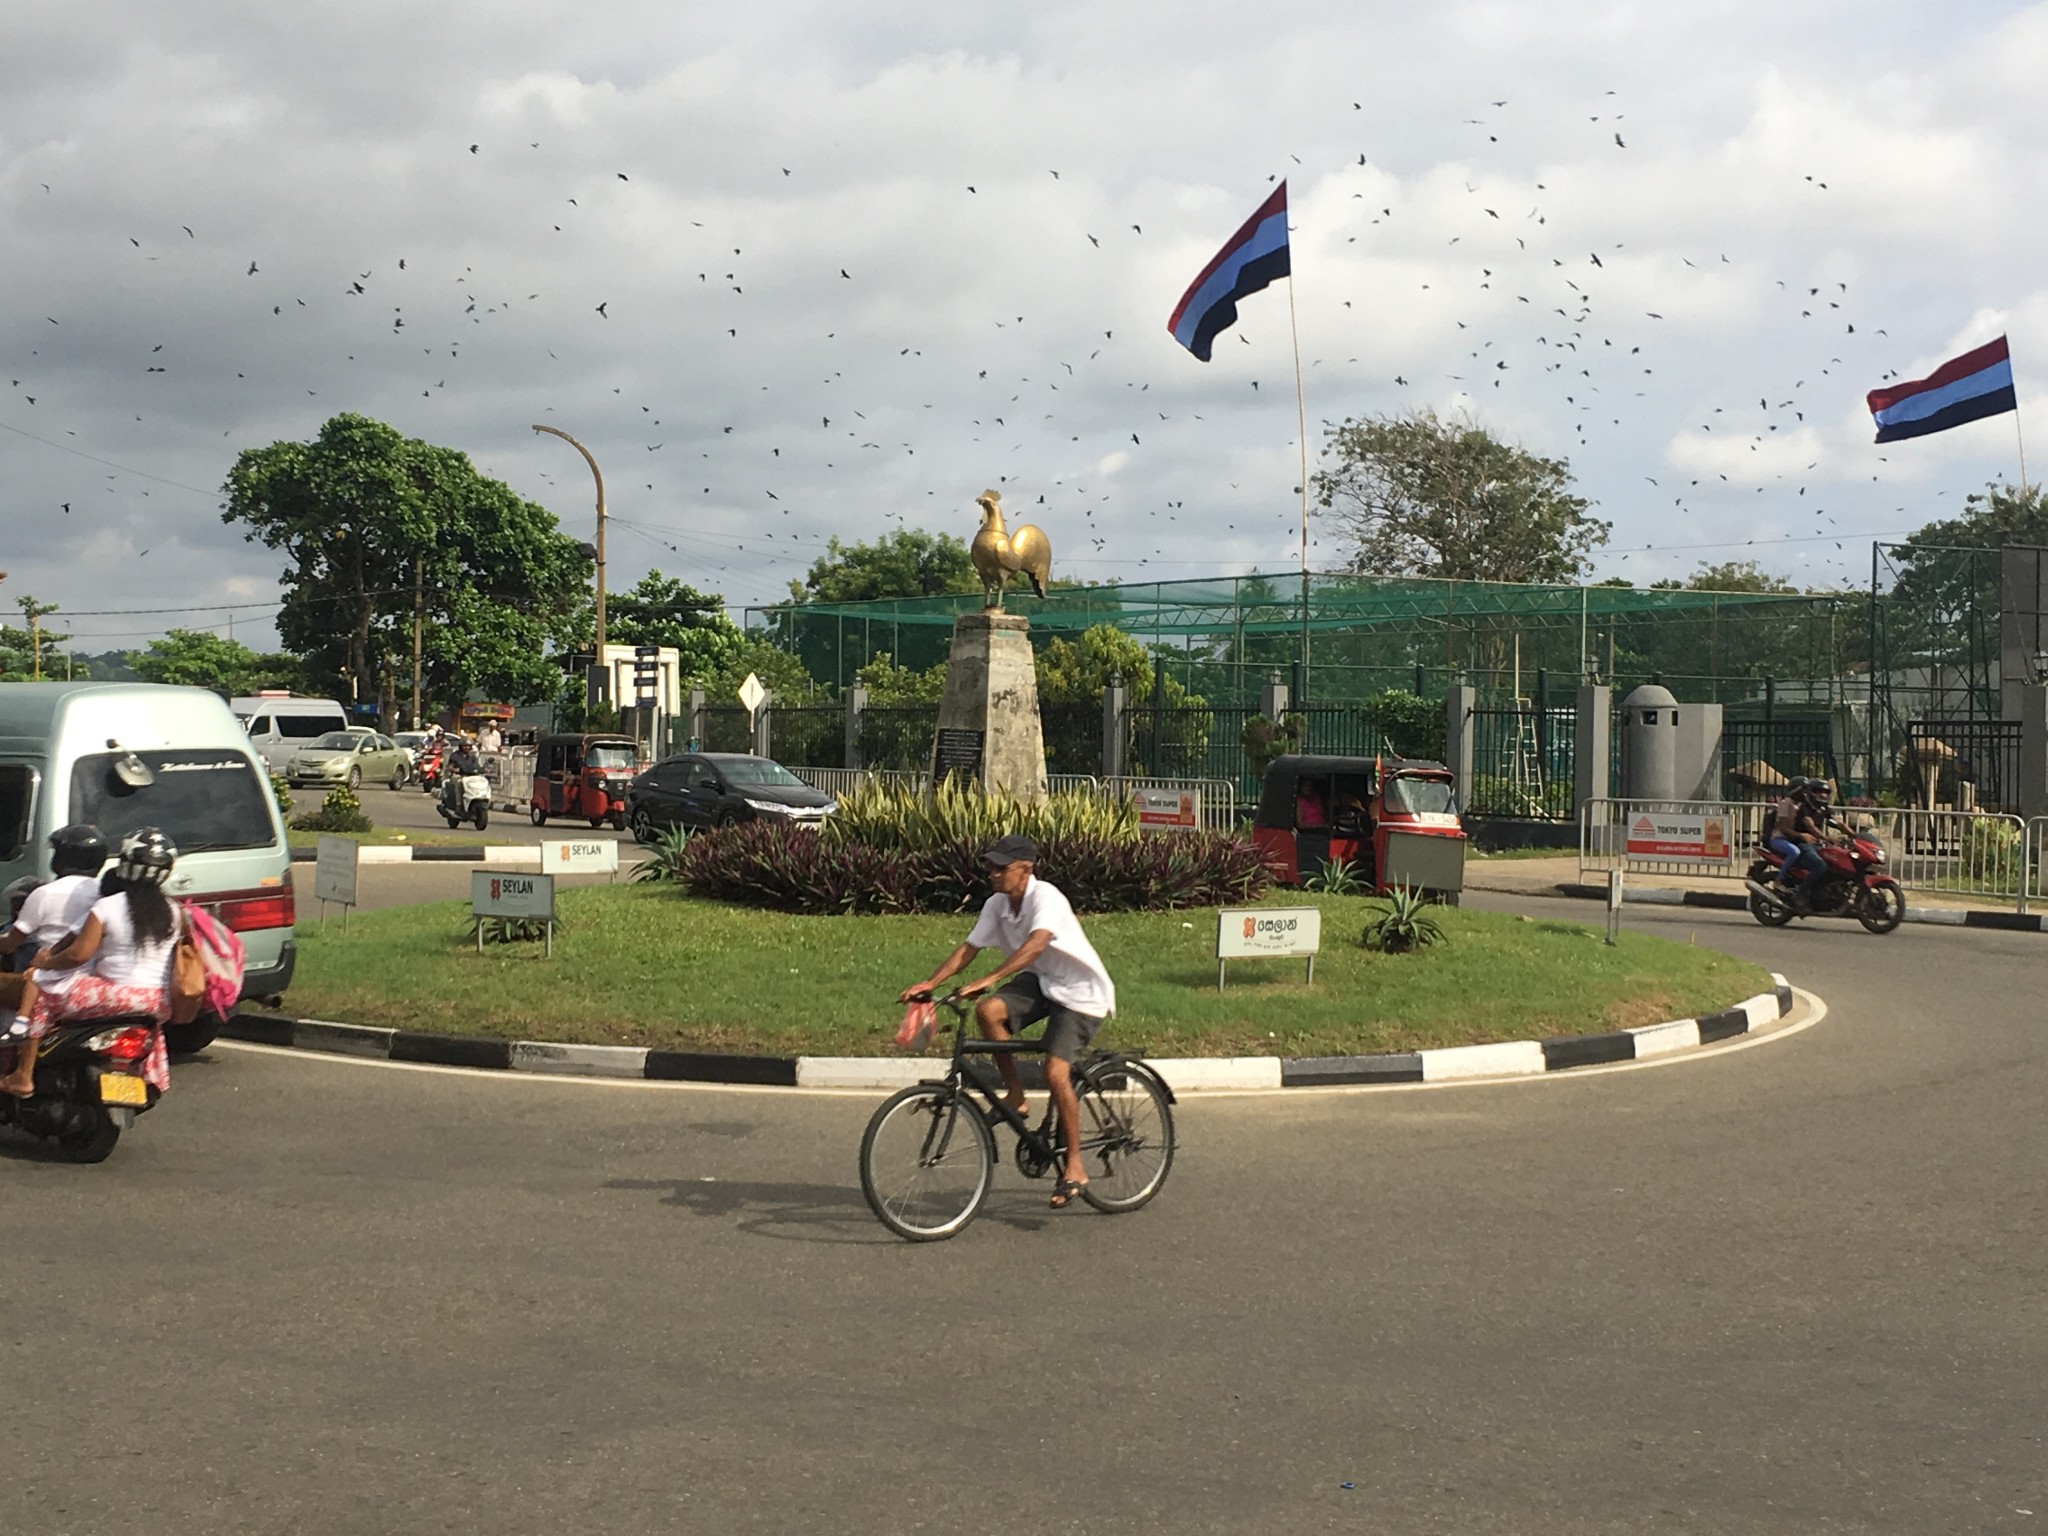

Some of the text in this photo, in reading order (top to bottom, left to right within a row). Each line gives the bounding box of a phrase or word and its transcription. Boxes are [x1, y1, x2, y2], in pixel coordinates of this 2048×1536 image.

[1657, 826, 1678, 835] TOKYO
[1680, 827, 1702, 836] SUPER
[572, 844, 602, 856] SEYLAN
[502, 879, 534, 894] SEYLAN
[1257, 916, 1298, 933] සෙලාන්
